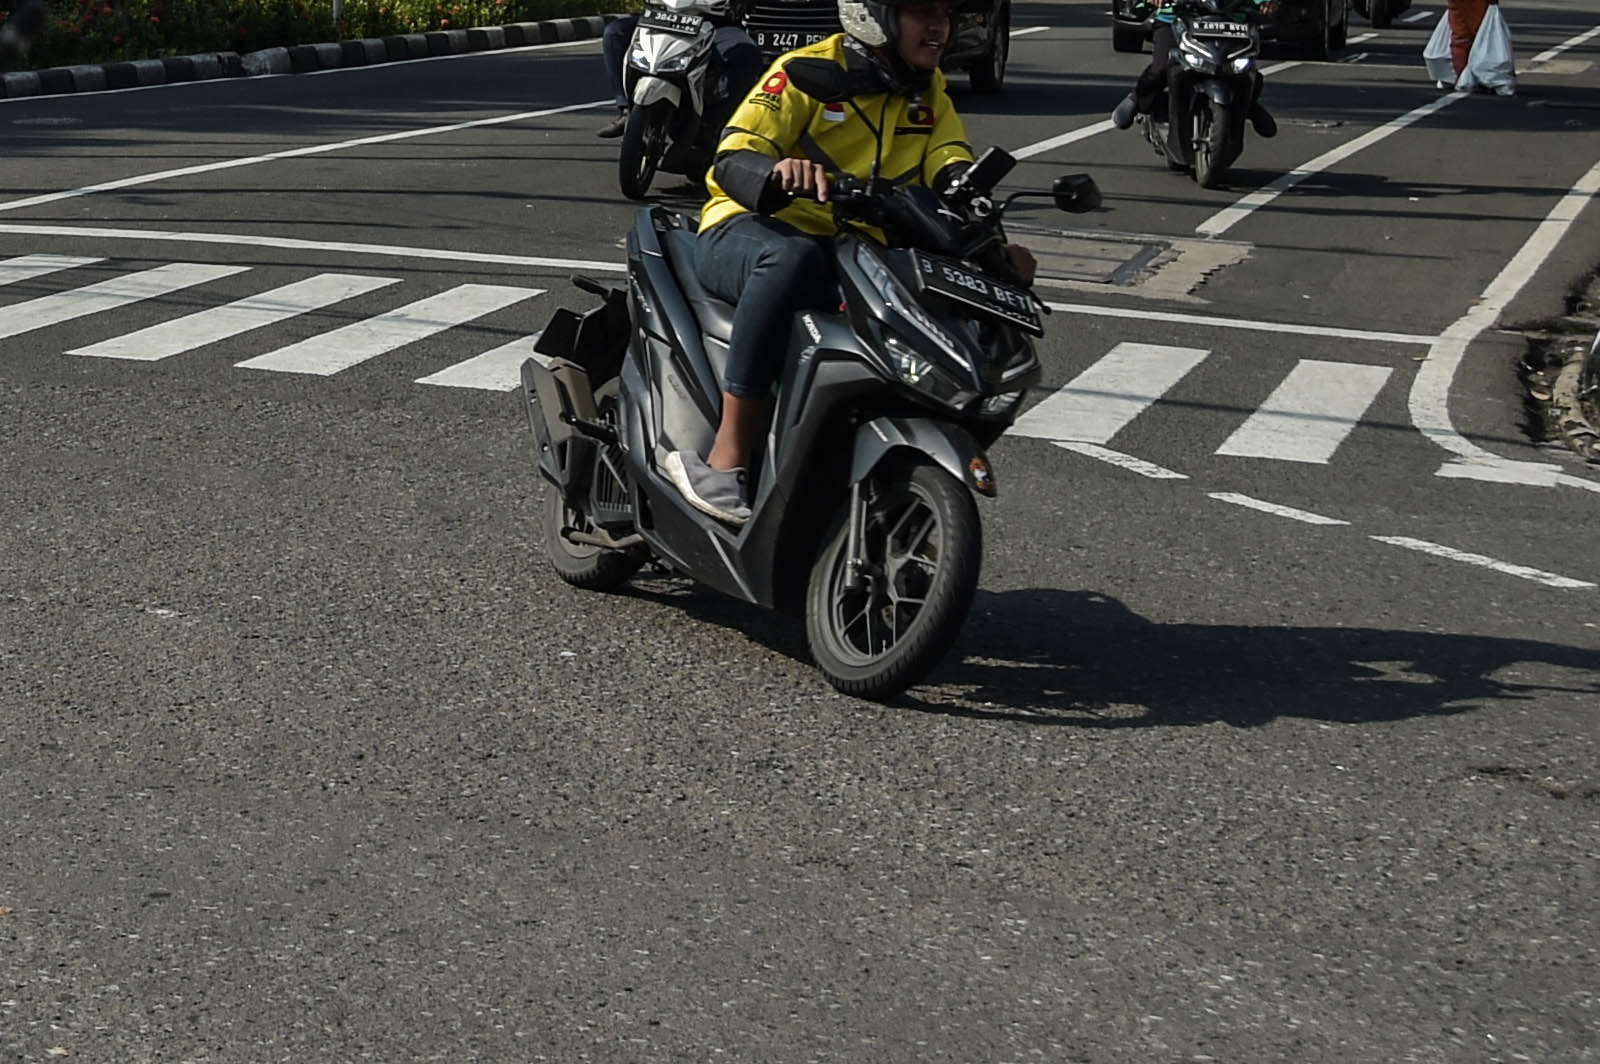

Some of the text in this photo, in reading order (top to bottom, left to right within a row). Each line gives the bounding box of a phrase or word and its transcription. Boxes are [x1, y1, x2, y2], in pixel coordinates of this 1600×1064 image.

[757, 32, 765, 46] B
[773, 33, 799, 47] 2447
[921, 258, 934, 274] B
[942, 266, 989, 295] 5383
